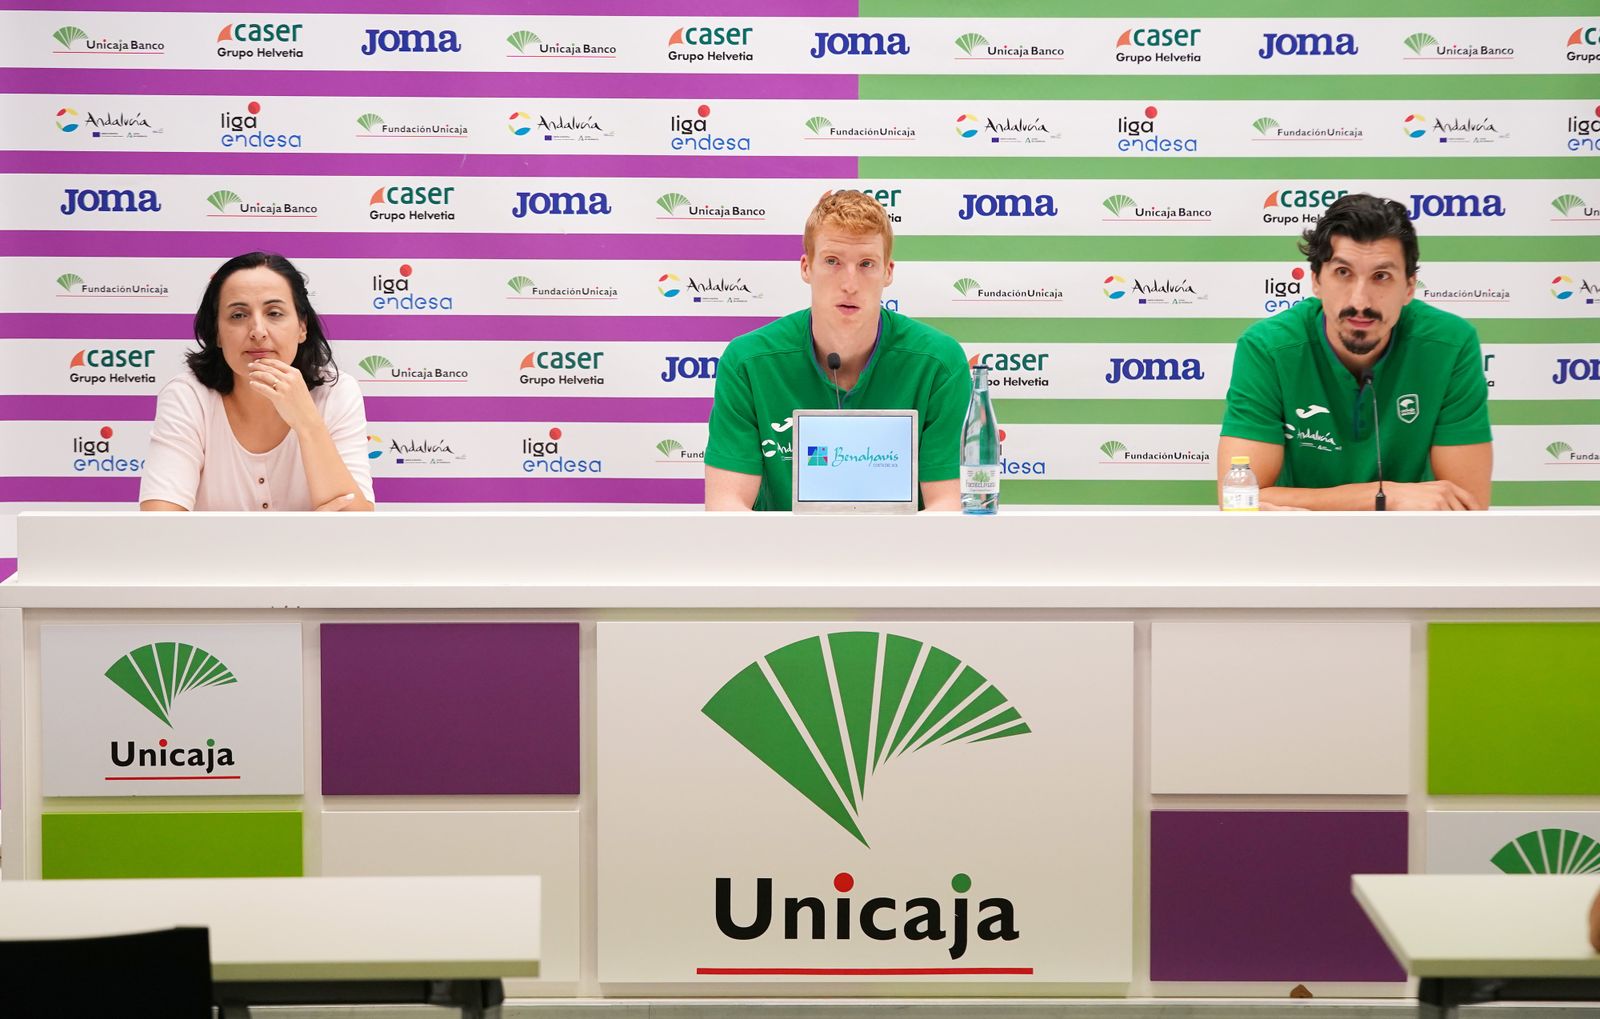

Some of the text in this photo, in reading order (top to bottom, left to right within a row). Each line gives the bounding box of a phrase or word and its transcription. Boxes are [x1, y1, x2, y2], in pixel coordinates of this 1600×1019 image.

[235, 24, 303, 42] caser
[686, 27, 753, 45] caser
[1134, 29, 1201, 46] caser
[87, 39, 164, 51] Unicaja Banco
[217, 47, 303, 59] Grupo Helvetia
[540, 43, 616, 55] Unicaja Banco
[988, 45, 1064, 57] Unicaja Banco
[1437, 45, 1514, 57] Unicaja Banco
[668, 51, 753, 63] Grupo Helvetia
[1116, 53, 1201, 64] Grupo Helvetia
[221, 111, 257, 131] liga
[672, 115, 707, 135] liga
[1119, 117, 1154, 136] liga
[221, 131, 301, 147] endesa
[671, 134, 750, 150] endesa
[1118, 135, 1197, 152] endesa
[387, 187, 454, 204] caser
[240, 203, 317, 215] Unicaja Banco
[689, 205, 765, 217] Unicaja Banco
[1136, 207, 1211, 219] Unicaja Banco
[1407, 194, 1506, 221] Joma
[370, 210, 455, 222] Grupo Helvetia
[1263, 214, 1299, 226] Grupo
[373, 276, 409, 294] liga
[1265, 278, 1300, 297] liga
[373, 293, 452, 310] endesa
[87, 350, 155, 367] caser
[537, 352, 604, 369] caser
[982, 353, 1049, 371] caser
[392, 368, 468, 379] Unicaja Banco
[661, 357, 720, 382] Jom
[70, 373, 155, 385] Grupo Helvetia
[520, 375, 604, 387] Grupo Helvetia
[1004, 377, 1048, 386] Helvetia
[74, 436, 109, 456] liga
[523, 439, 558, 457] liga
[73, 455, 145, 471] endes
[523, 456, 601, 472] endesa
[1000, 458, 1045, 474] desa
[110, 738, 235, 773] Unicaja
[714, 873, 1019, 960] Unicaja
